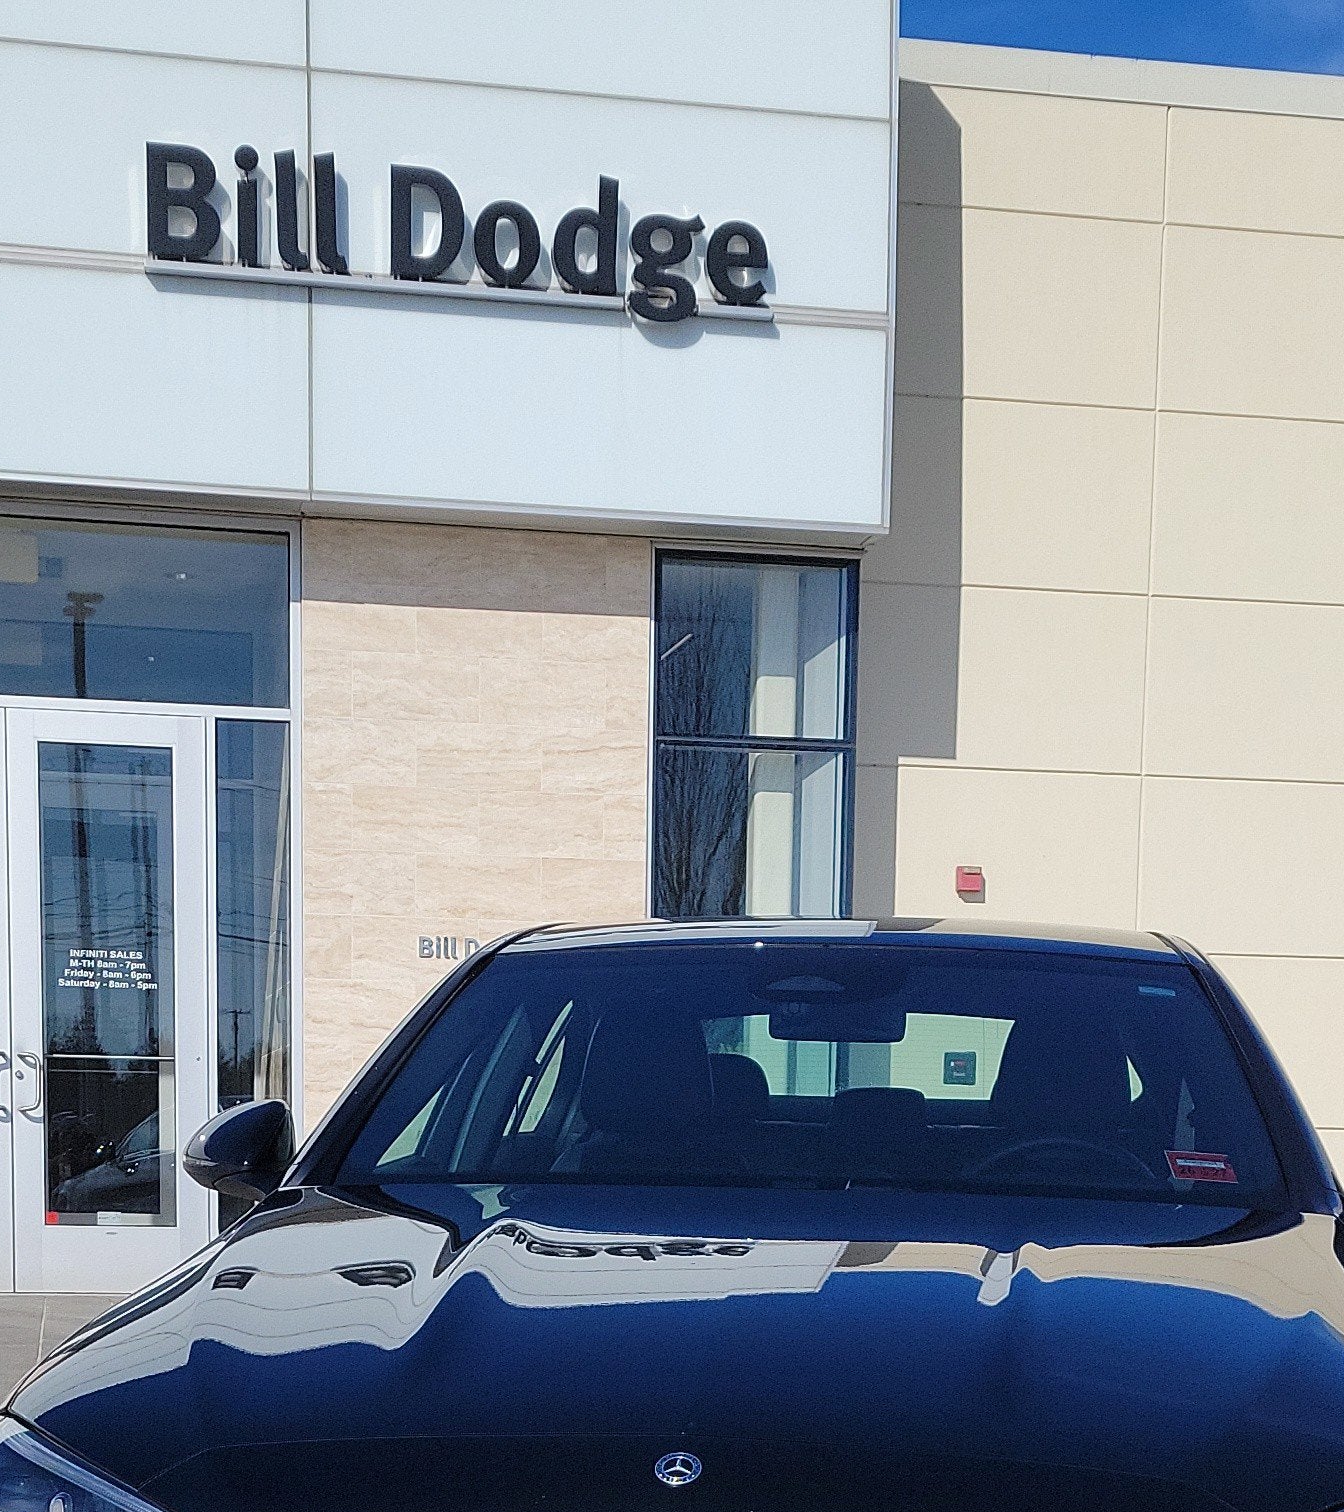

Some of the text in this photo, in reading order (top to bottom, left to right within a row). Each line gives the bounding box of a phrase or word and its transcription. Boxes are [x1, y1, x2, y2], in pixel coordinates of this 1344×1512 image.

[146, 140, 769, 323] Bill Dodge
[418, 935, 458, 960] Bill
[69, 949, 143, 960] INFINITI SALES
[69, 959, 95, 968] M-TH
[97, 960, 118, 969] 8am
[124, 961, 146, 971] 7pm
[64, 968, 95, 979] Friday
[58, 978, 101, 989] Saturday
[137, 981, 158, 991] 5pm
